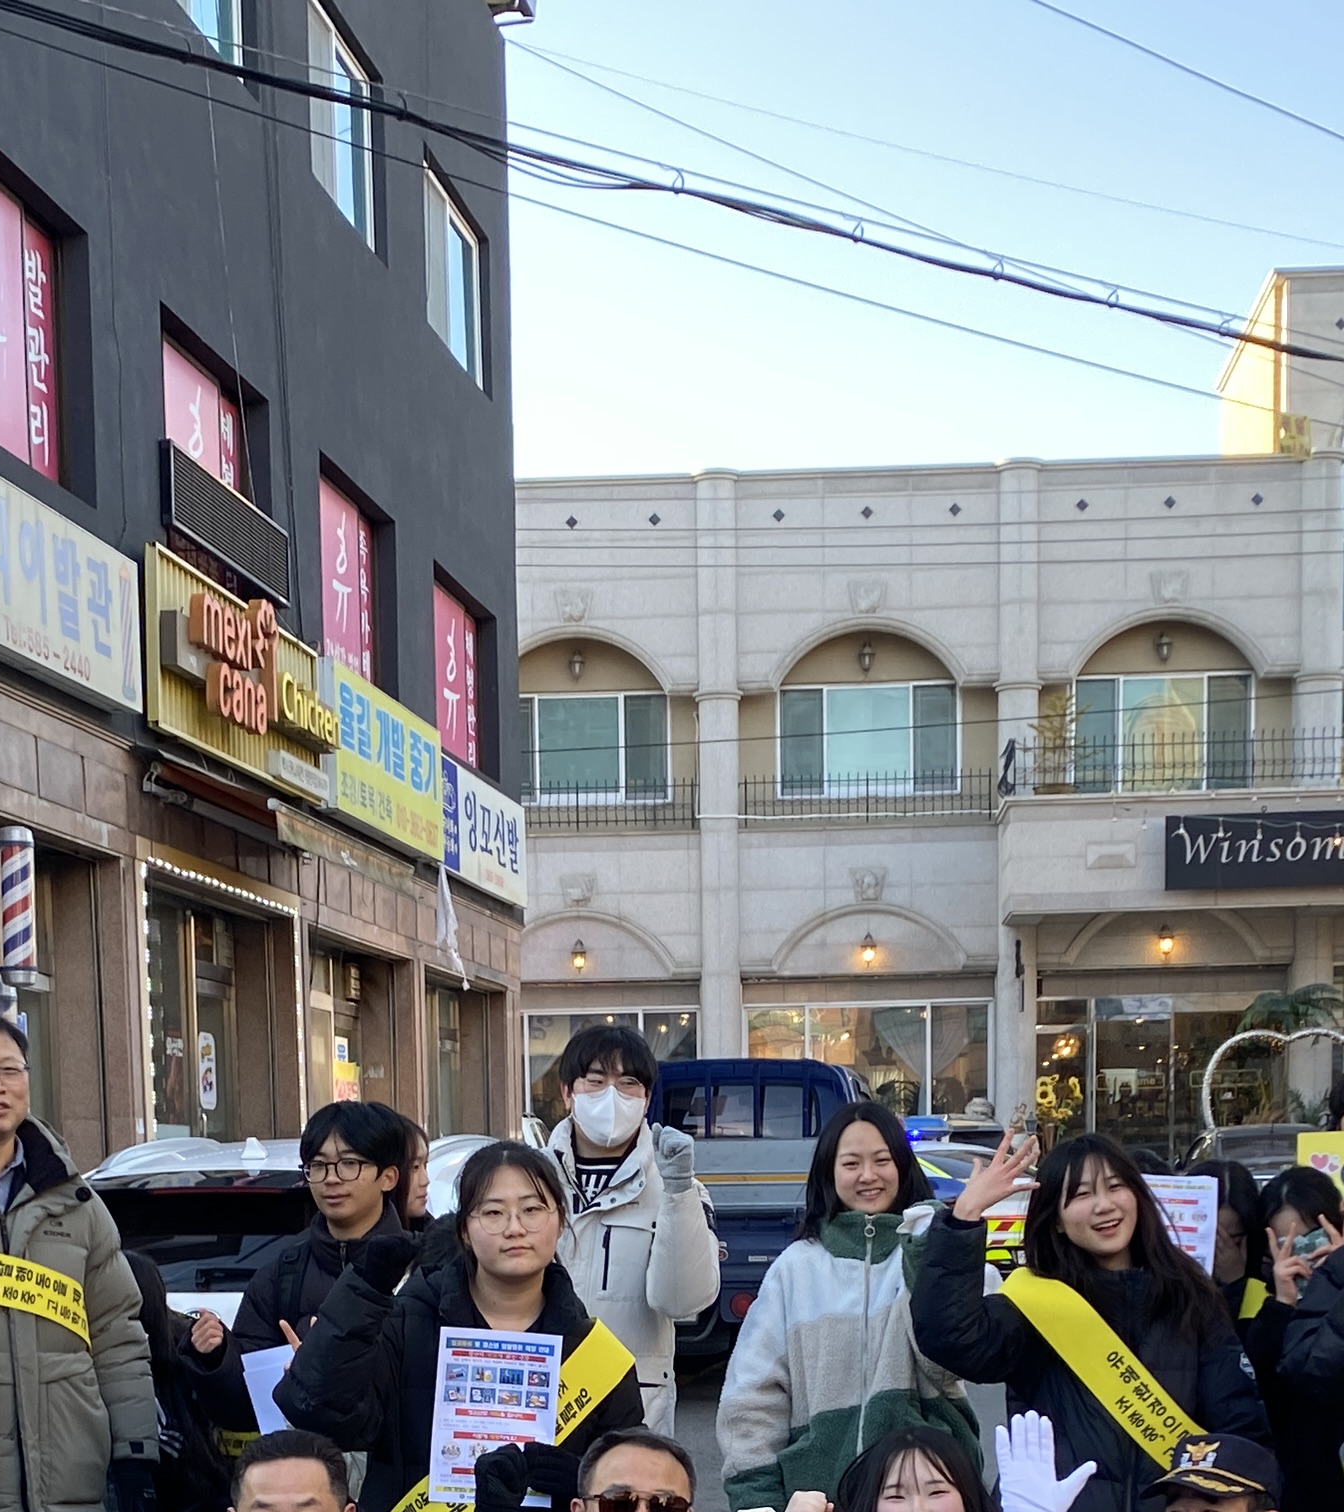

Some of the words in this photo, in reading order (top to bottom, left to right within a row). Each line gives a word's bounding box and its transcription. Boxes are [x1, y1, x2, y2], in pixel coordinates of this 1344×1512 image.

[201, 595, 253, 671] mexi
[218, 662, 268, 736] cana
[282, 671, 340, 745] Chicken
[375, 709, 406, 782] 개발
[408, 728, 439, 803] 중기
